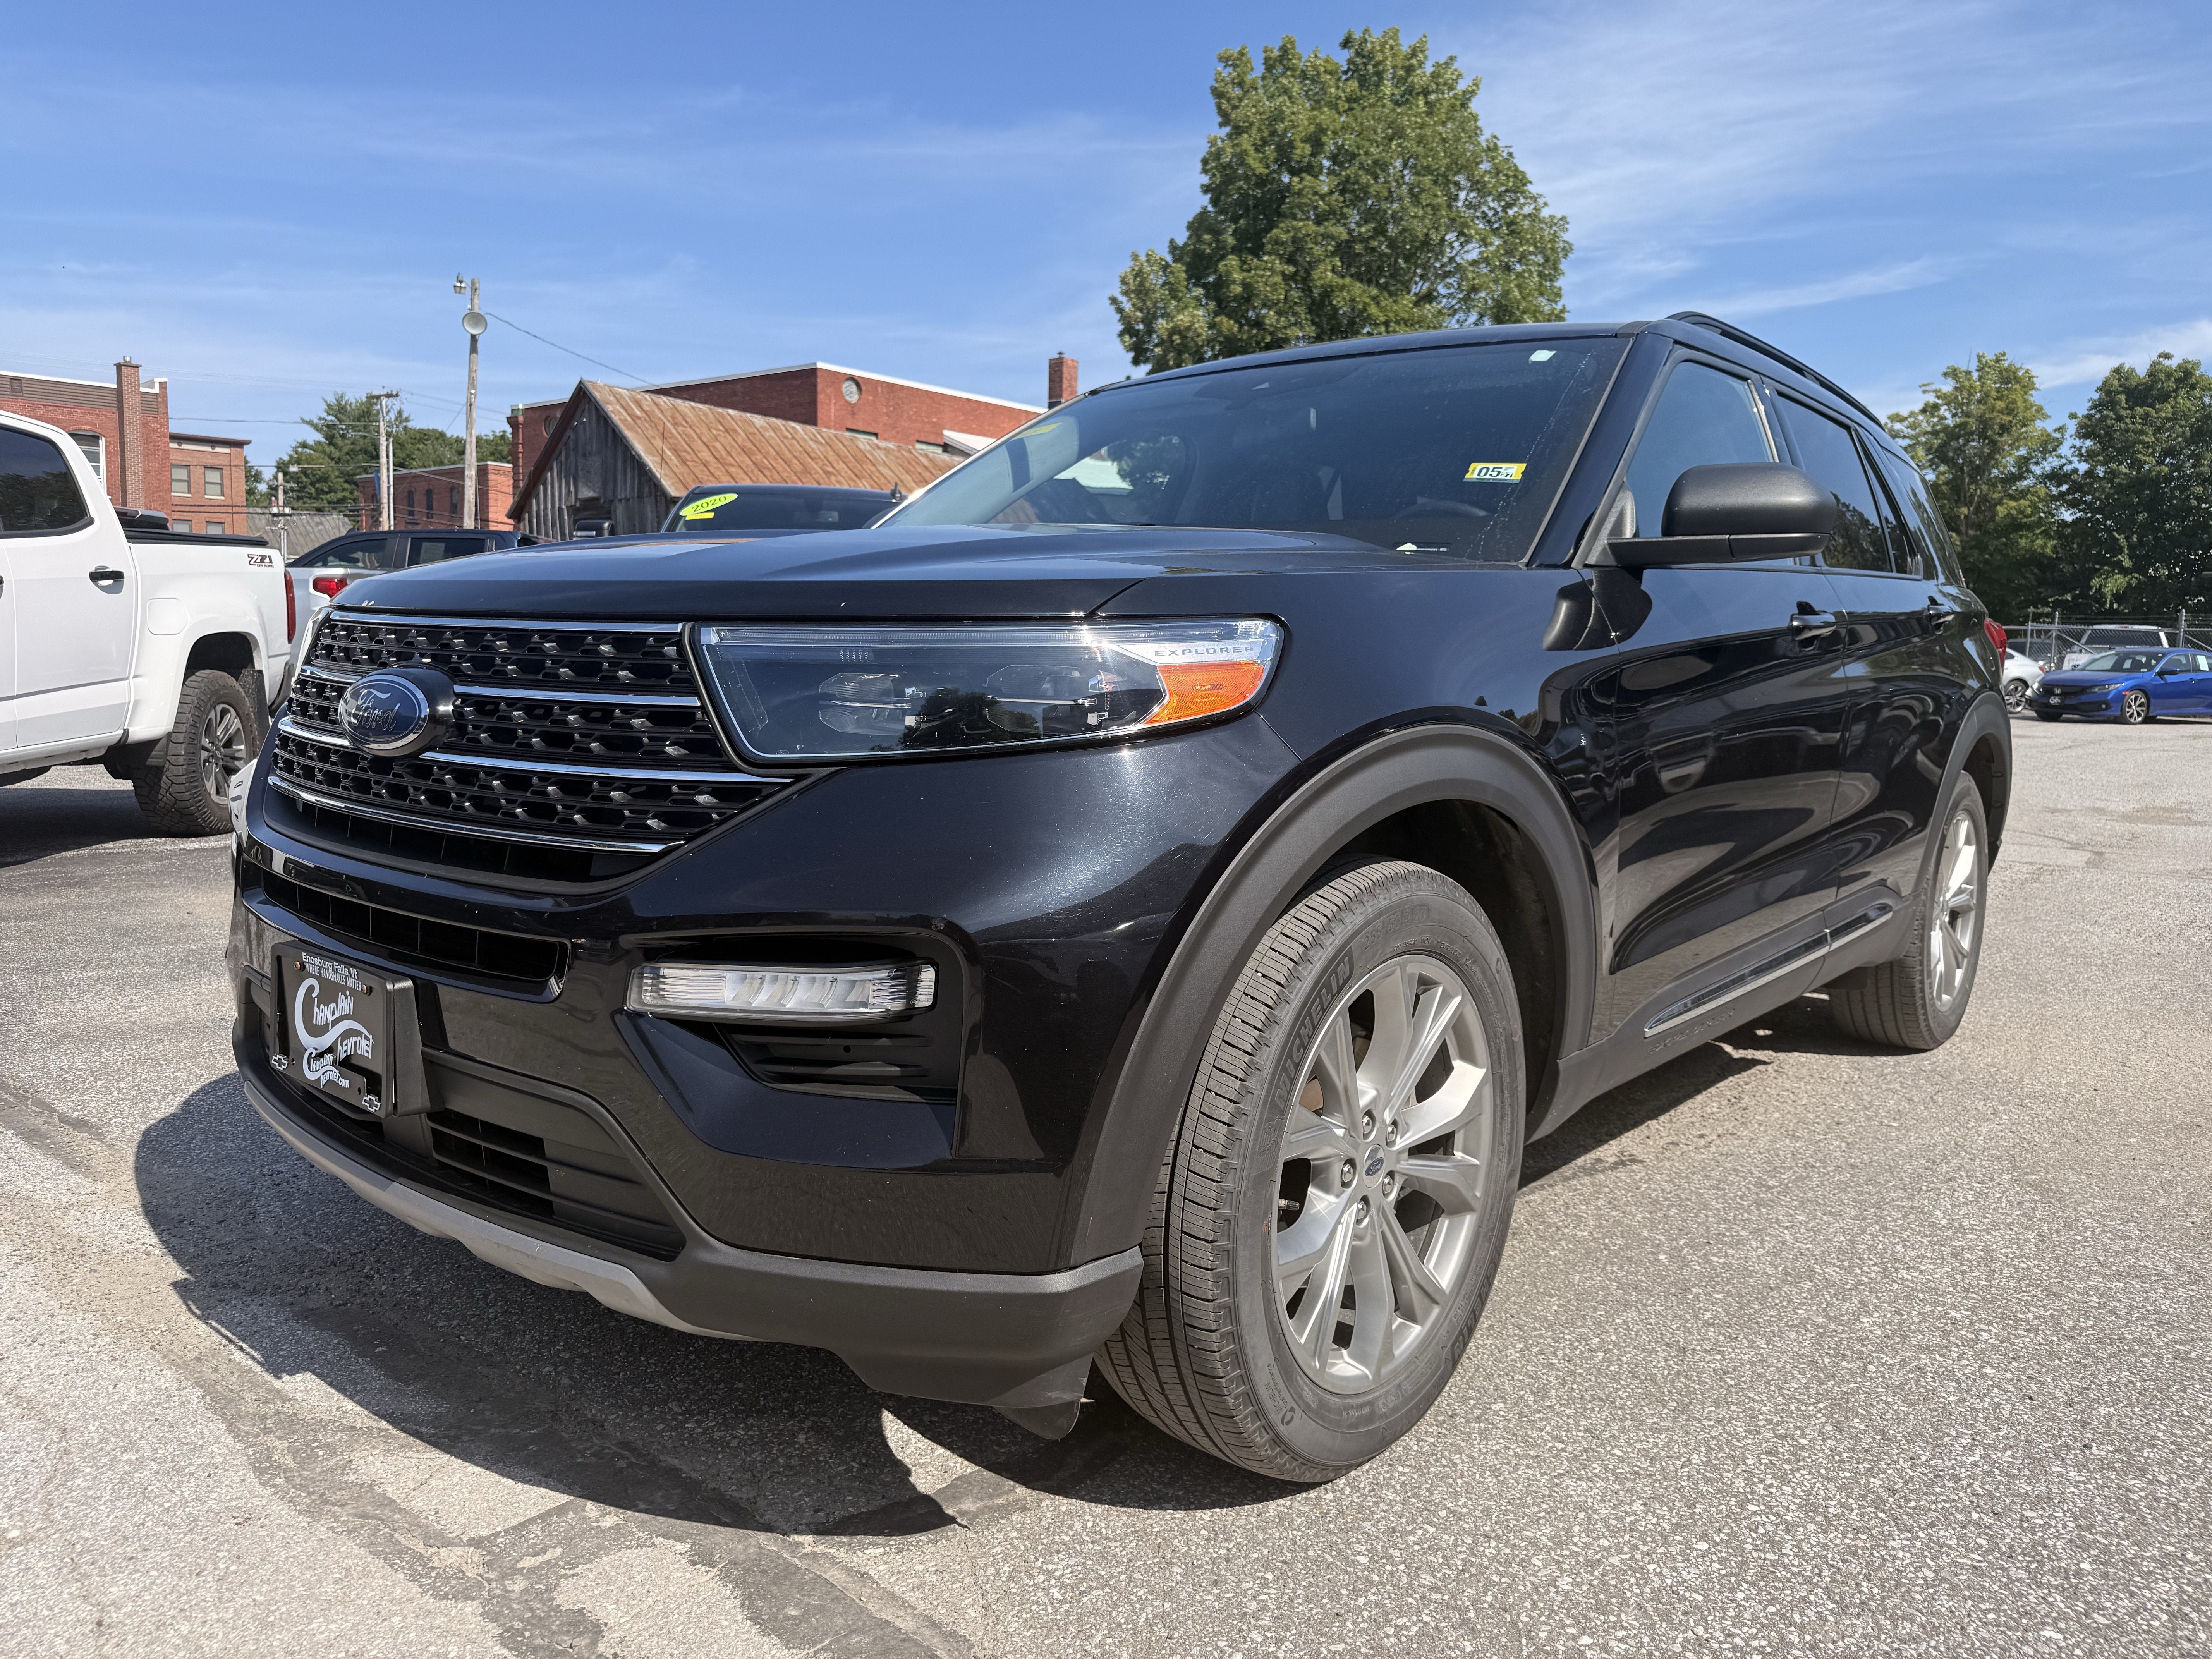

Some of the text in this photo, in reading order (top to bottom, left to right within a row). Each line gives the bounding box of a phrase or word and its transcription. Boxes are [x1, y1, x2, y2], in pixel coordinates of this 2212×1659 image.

[1477, 466, 1503, 477] 05
[692, 496, 726, 513] 2020
[247, 554, 273, 565] Z71
[1154, 646, 1254, 656] EXPLORER
[351, 688, 401, 731] Ford
[302, 952, 333, 972] Enosburg
[350, 967, 358, 979] Vt
[320, 967, 346, 985] HANDSHAKES
[1275, 957, 1350, 1111] MICHELIN
[1369, 1160, 1382, 1175] Ford
[1267, 1363, 1282, 1398] Performance
[1264, 1381, 1283, 1414] MICHELIN
